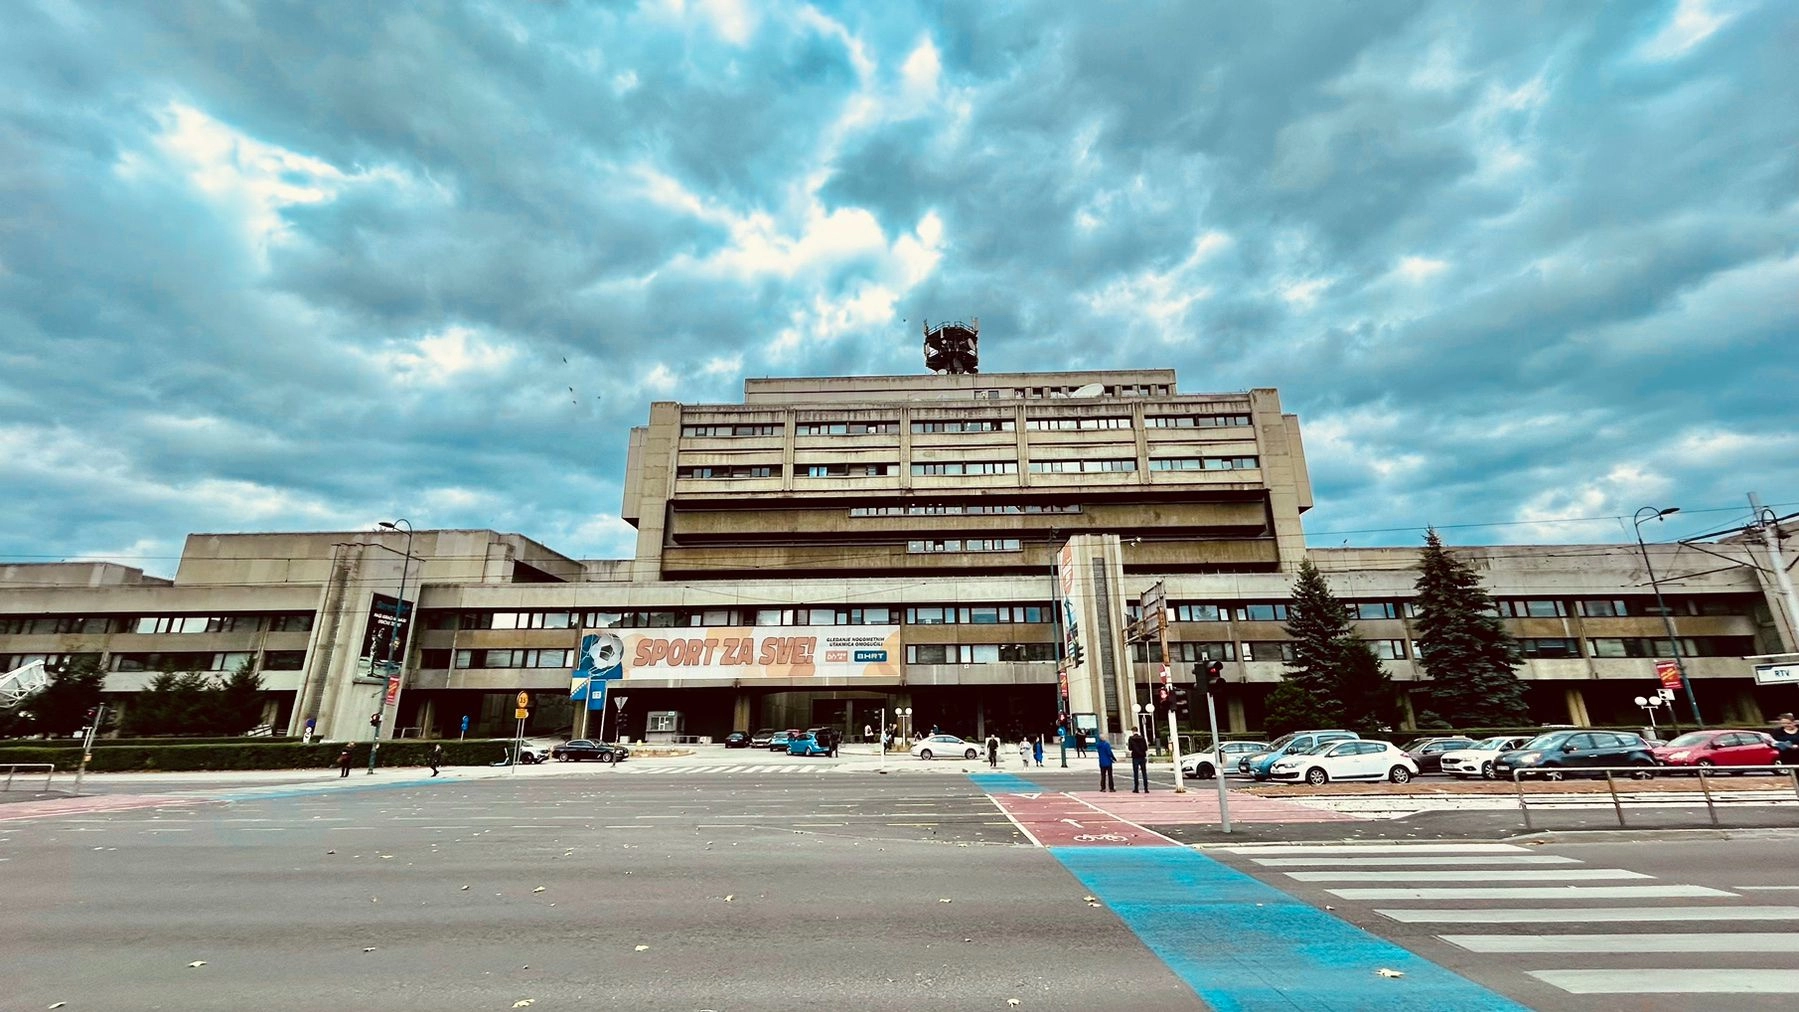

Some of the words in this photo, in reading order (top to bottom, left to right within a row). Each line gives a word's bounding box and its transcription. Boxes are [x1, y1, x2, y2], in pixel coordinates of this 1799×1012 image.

[632, 638, 719, 667] SPORT
[719, 638, 754, 666] ZA
[758, 637, 817, 665] SVE!
[1774, 669, 1790, 677] RTV
